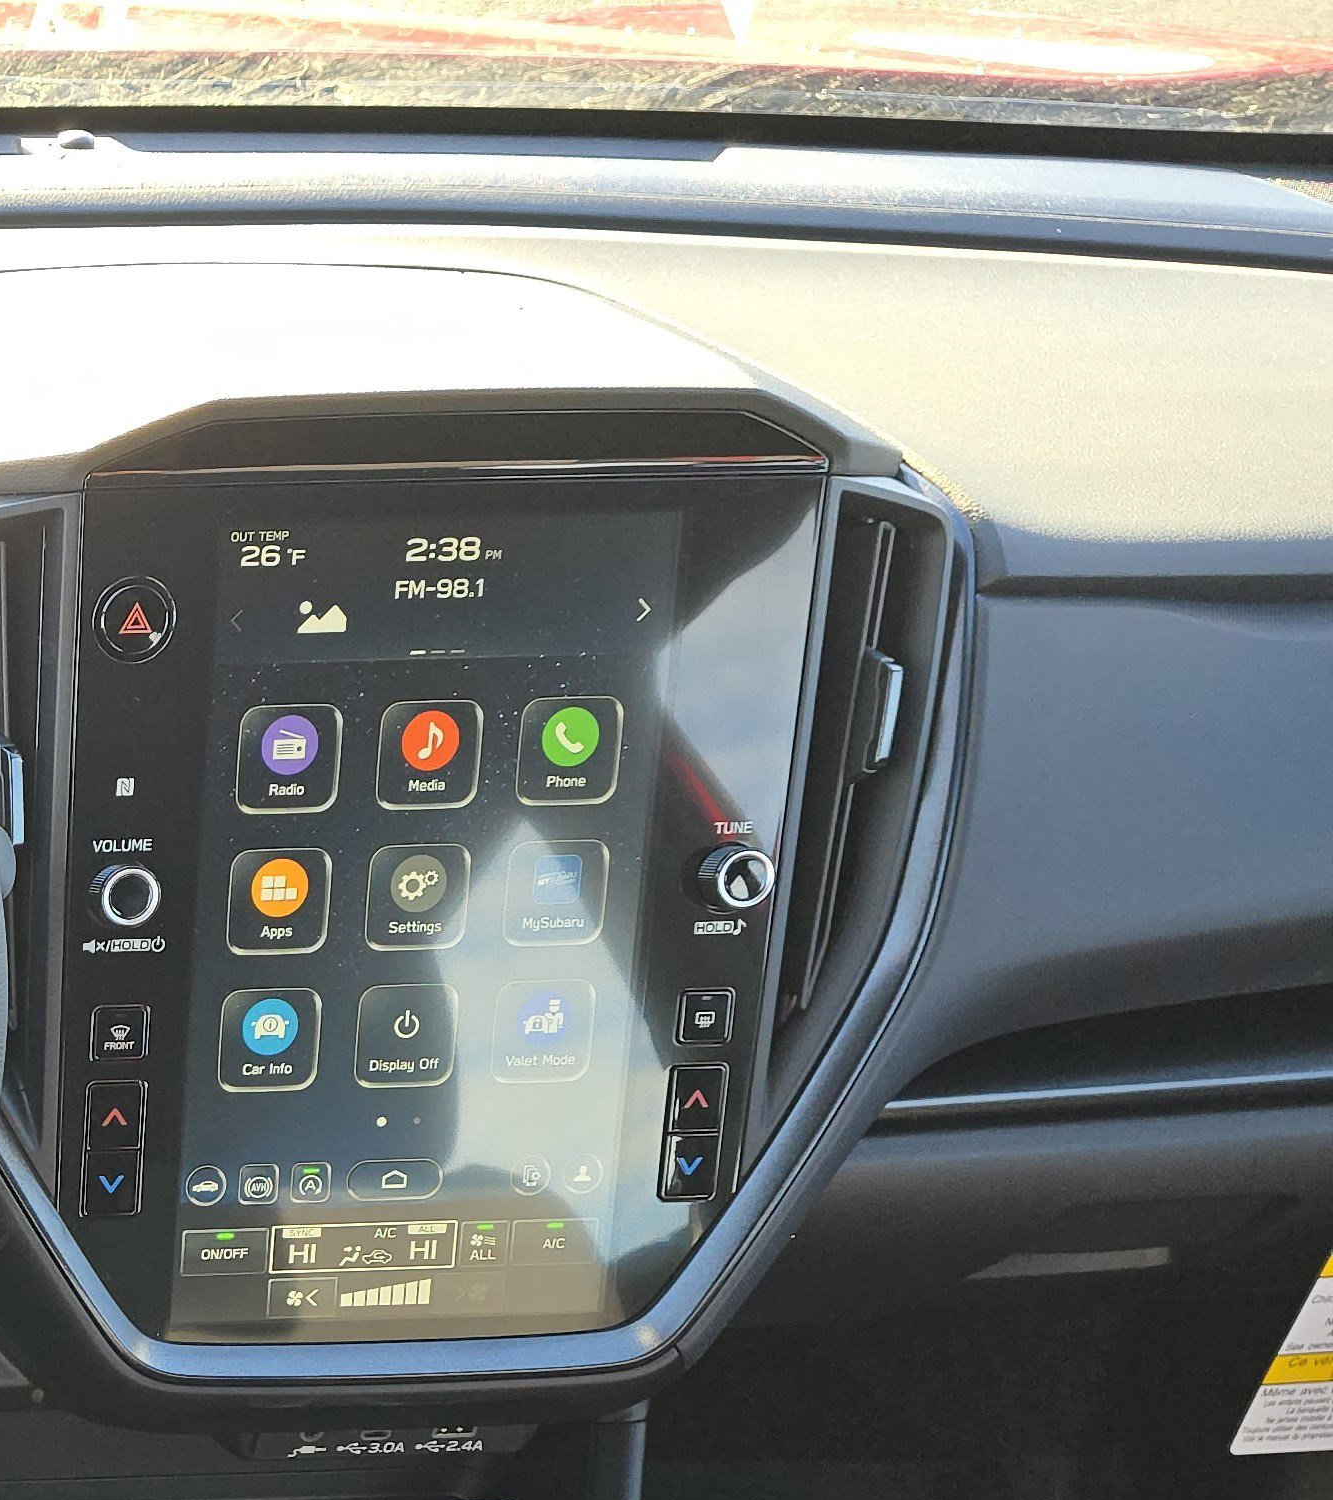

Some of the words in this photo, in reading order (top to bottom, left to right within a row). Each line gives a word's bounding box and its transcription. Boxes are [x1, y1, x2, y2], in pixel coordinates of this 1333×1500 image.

[230, 531, 255, 543] OUT
[258, 530, 290, 542] TEMP
[240, 545, 281, 567] 26
[405, 536, 482, 563] 2:38
[484, 549, 503, 560] PM
[394, 578, 485, 600] FM-98.1
[408, 778, 446, 792] Media
[546, 775, 587, 788] Phone
[268, 782, 305, 797] Radio
[713, 821, 754, 835] TUNE
[92, 838, 154, 853] VOLUME
[388, 921, 442, 936] Settings
[521, 916, 585, 932] MySubaru
[695, 923, 733, 934] HOLD
[259, 925, 293, 940] Apps
[111, 938, 150, 951] HOLD
[103, 1040, 135, 1051] FRONT
[369, 1058, 415, 1073] Display
[419, 1057, 440, 1070] Off
[505, 1054, 538, 1067] Valet
[542, 1053, 576, 1066] Mode
[242, 1063, 266, 1076] Car
[269, 1061, 293, 1075] Info
[288, 1227, 316, 1237] SYNC
[373, 1227, 397, 1239] A/C
[542, 1236, 566, 1250] A/C
[200, 1247, 249, 1261] ON/OFF
[288, 1243, 317, 1264] HI
[409, 1240, 437, 1261] HI
[469, 1248, 497, 1261] ALL
[367, 1441, 405, 1454] 3.0A
[445, 1440, 483, 1452] 2.4A
